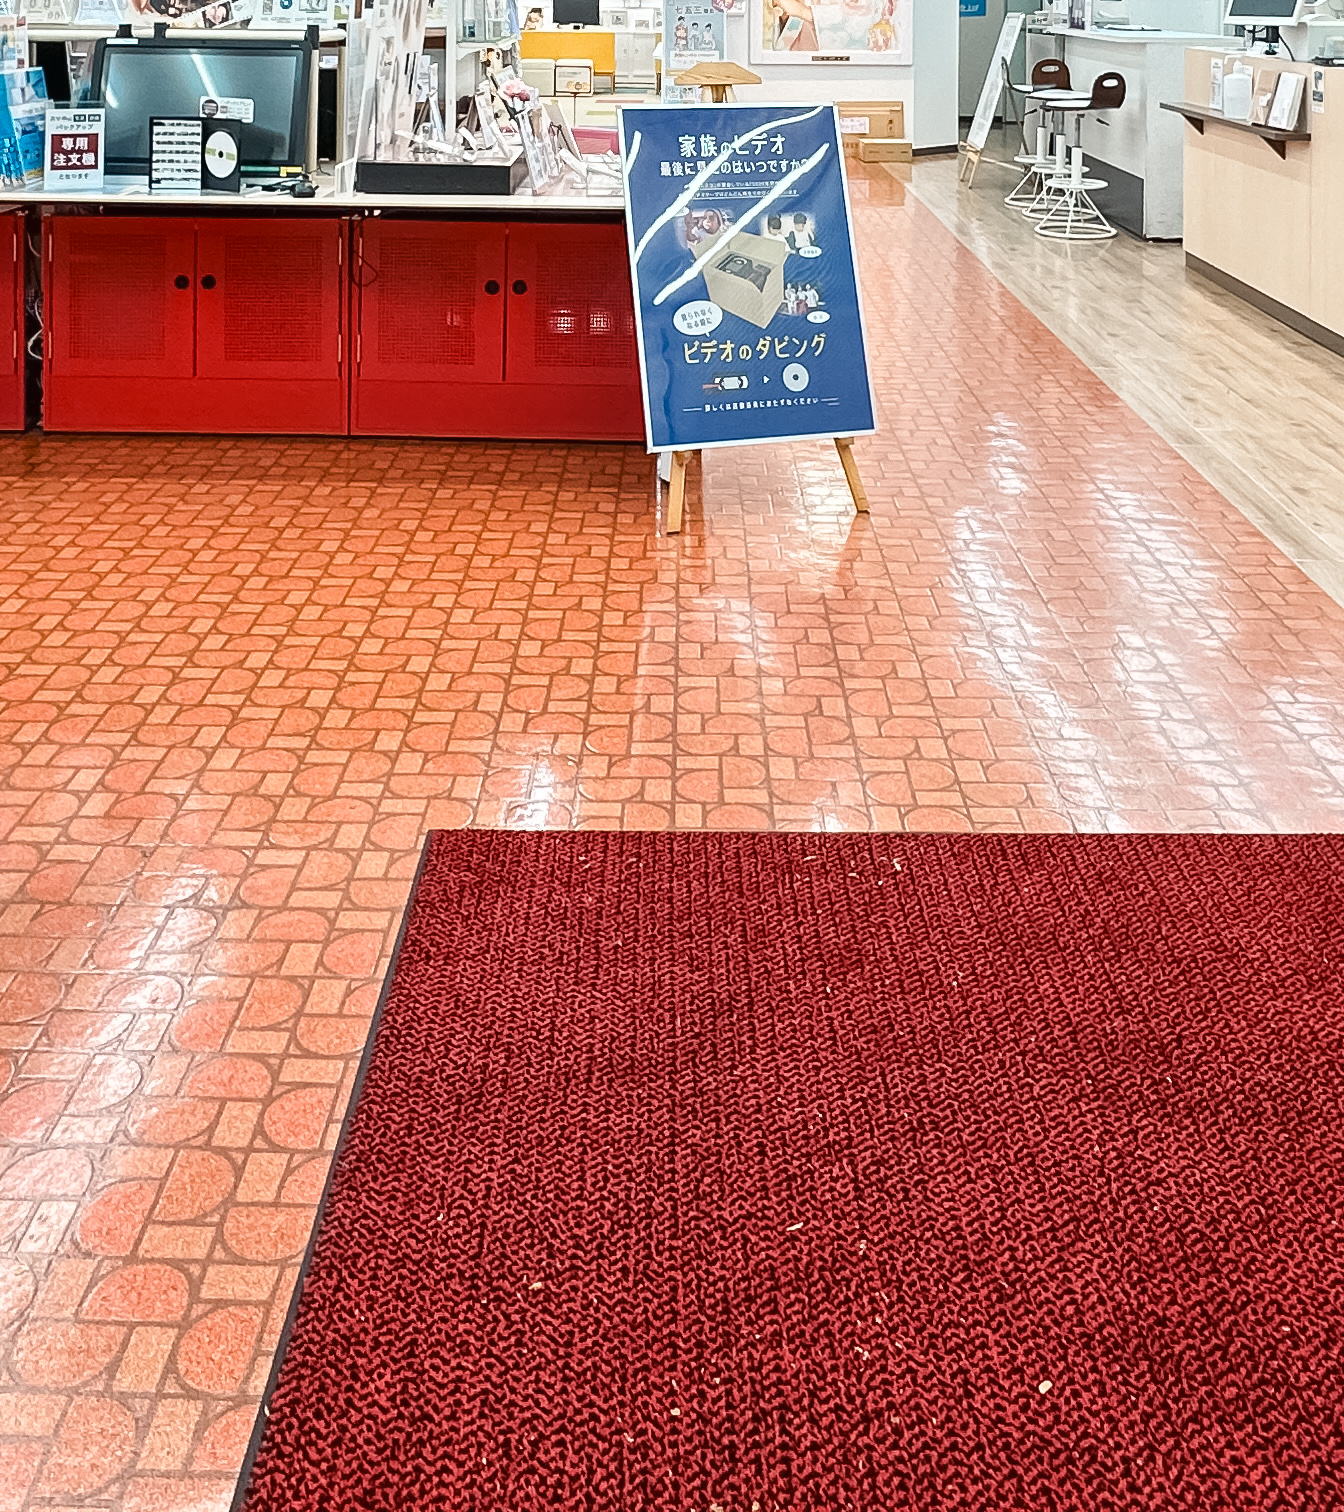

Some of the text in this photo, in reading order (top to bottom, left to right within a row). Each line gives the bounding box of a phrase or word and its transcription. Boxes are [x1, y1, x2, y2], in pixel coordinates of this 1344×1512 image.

[61, 137, 88, 150] 専用
[53, 153, 96, 166] 注文機
[683, 332, 827, 364] ビデオのダビング
